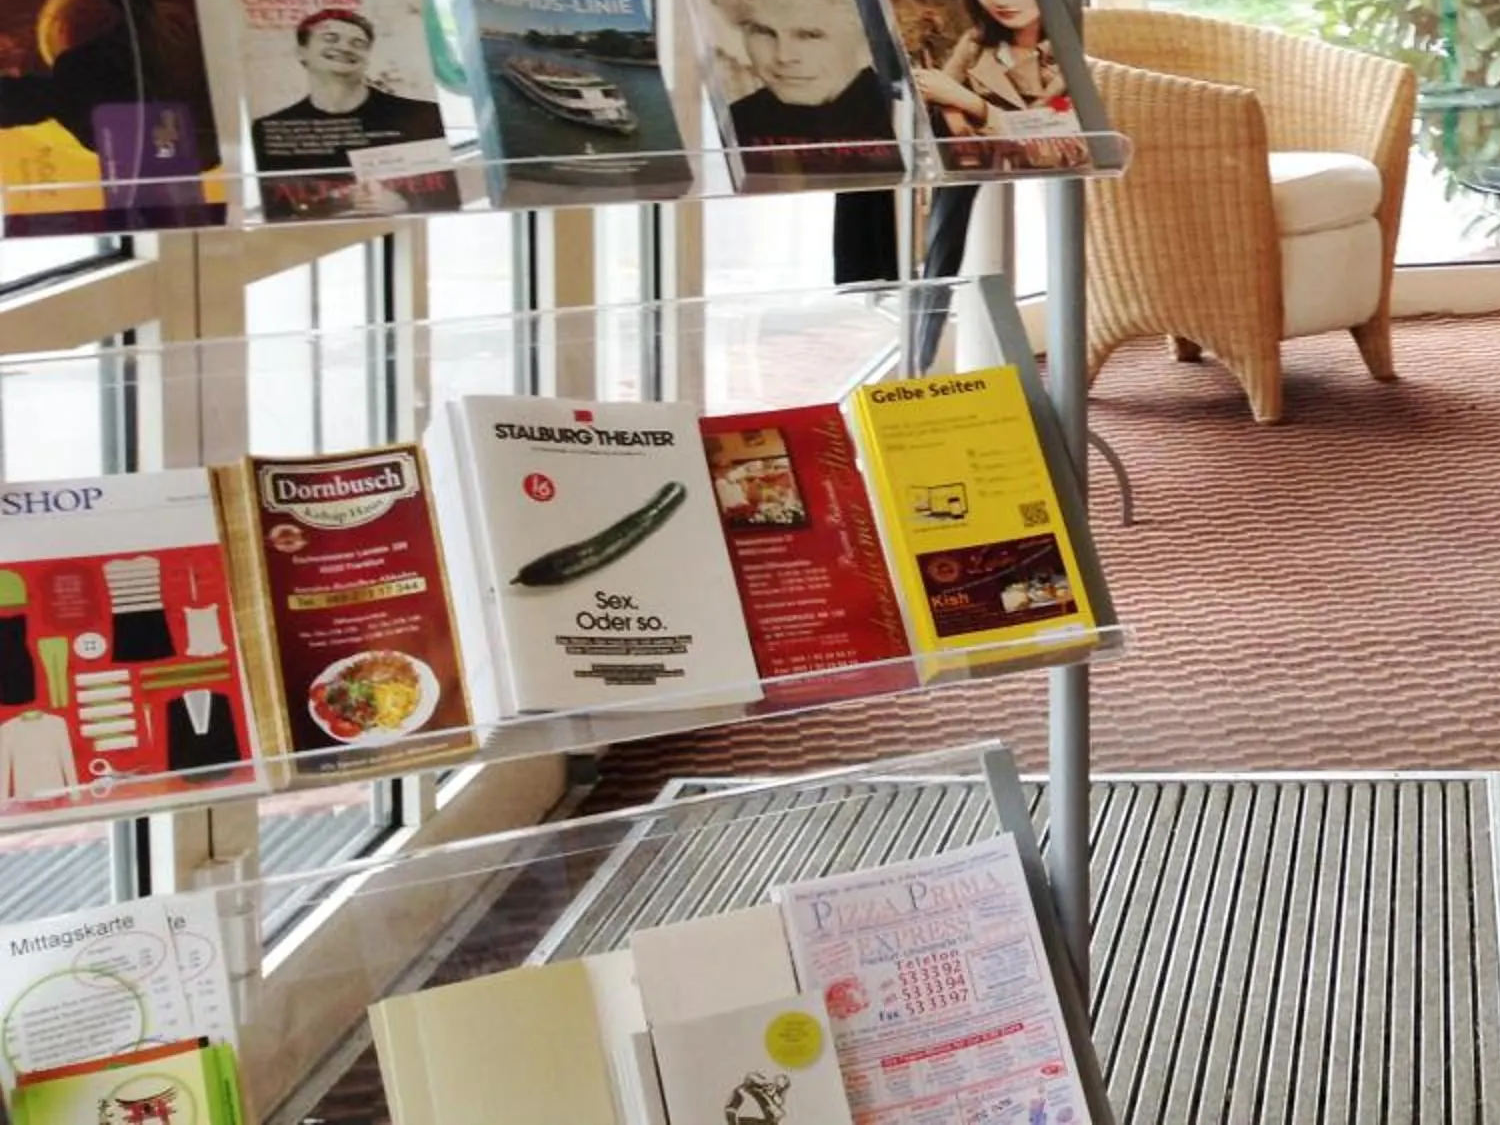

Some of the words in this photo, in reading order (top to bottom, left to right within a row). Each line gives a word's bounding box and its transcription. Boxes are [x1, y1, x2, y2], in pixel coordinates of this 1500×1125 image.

[872, 386, 925, 404] Gelbe
[929, 378, 987, 398] Seiten
[495, 423, 594, 445] STALBURG
[595, 429, 675, 447] THEATER
[277, 467, 401, 500] Dornbusch
[1, 487, 103, 516] SHOP
[594, 591, 639, 610] Sex.
[931, 590, 970, 607] Kish
[576, 611, 631, 631] Oder
[637, 616, 668, 631] so.
[810, 897, 902, 931] PIZZA
[908, 872, 1003, 911] PRIMA
[10, 914, 136, 957] Mittagskarte
[858, 918, 972, 958] EXPRESS
